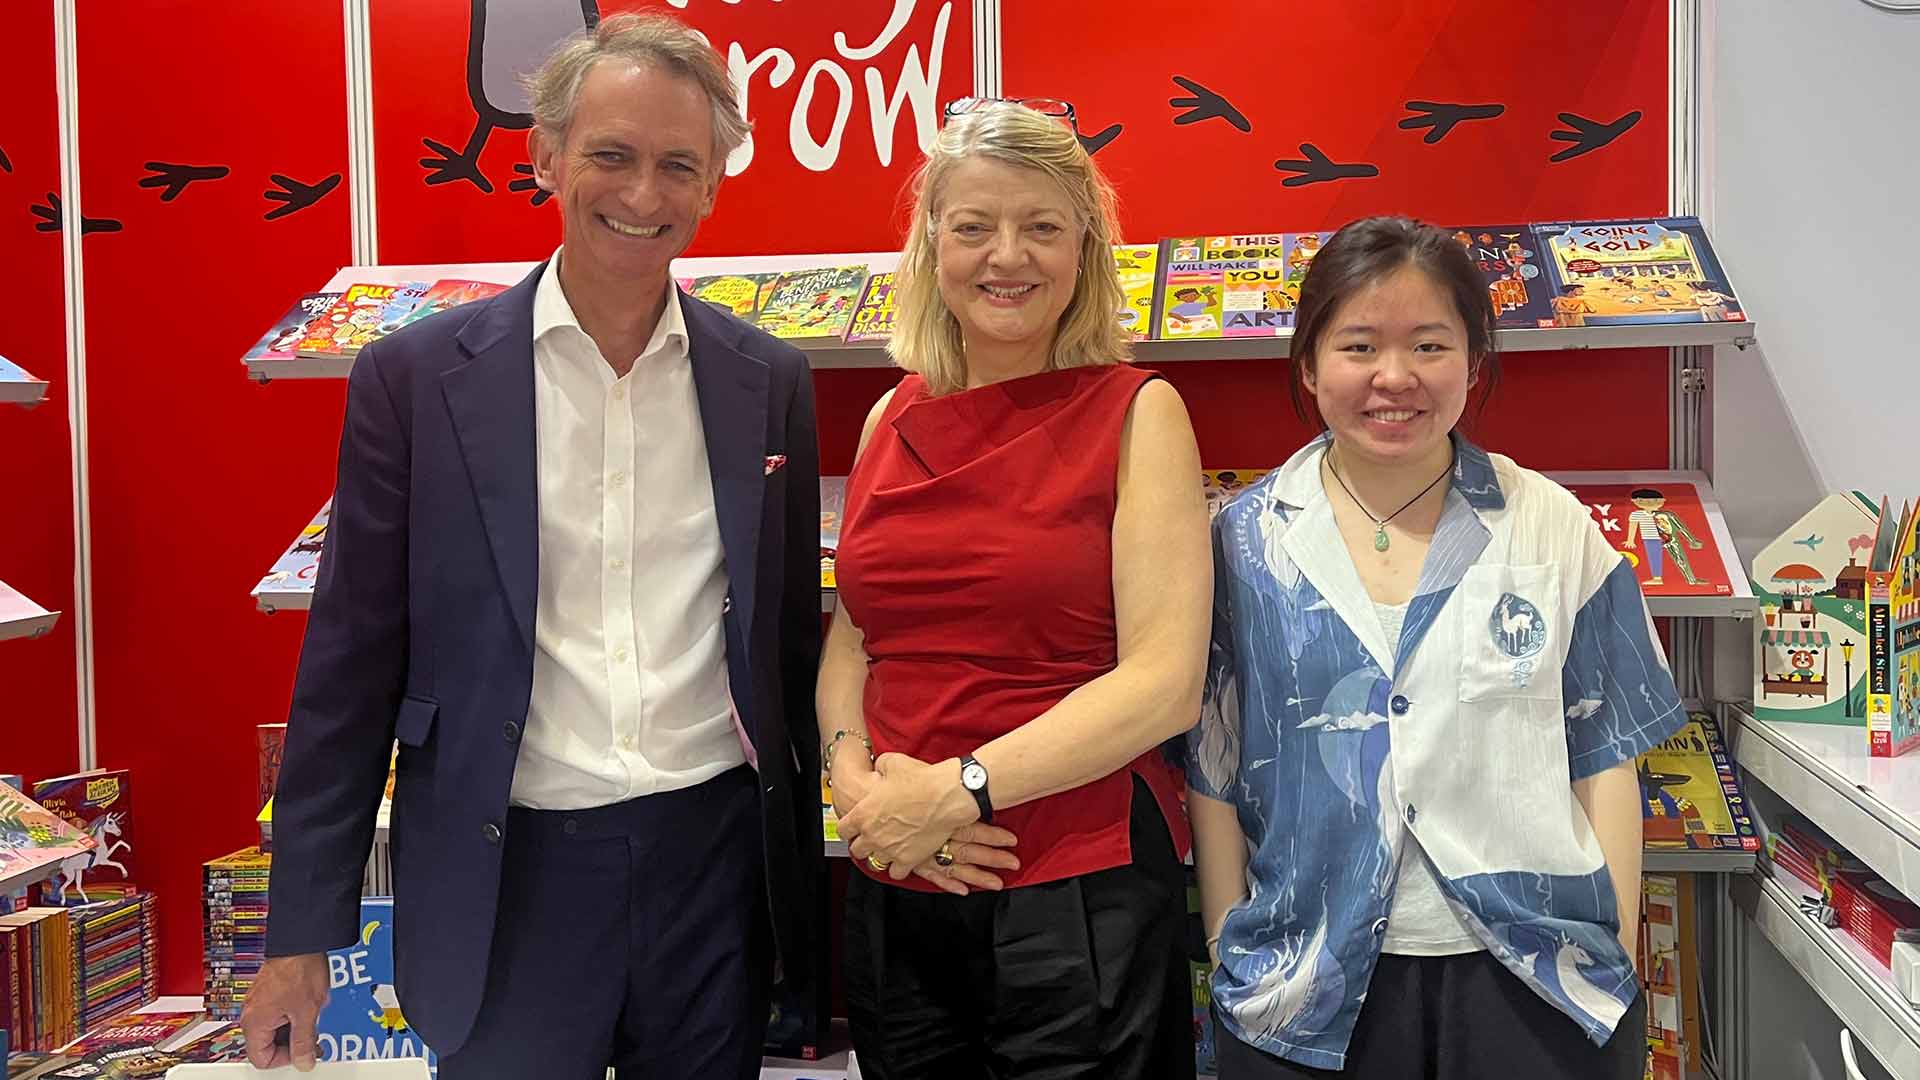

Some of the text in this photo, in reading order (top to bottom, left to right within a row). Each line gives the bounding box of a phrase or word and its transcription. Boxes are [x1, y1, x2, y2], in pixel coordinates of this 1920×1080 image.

[692, 2, 951, 177] row
[1581, 225, 1648, 237] GOING
[1234, 236, 1280, 246] THIS
[1583, 239, 1652, 252] GOLD
[1207, 248, 1279, 260] BOOK
[1171, 261, 1257, 271] WILL MAKE
[803, 271, 840, 286] FARM
[1229, 269, 1280, 282] YOU
[779, 278, 838, 299] BENEATH
[773, 292, 815, 306] WATER
[1873, 607, 1886, 656] Alphabet
[1875, 658, 1886, 692] Street
[43, 799, 66, 809] Olivia
[328, 951, 372, 989] BE
[316, 1031, 430, 1063] ORMA
